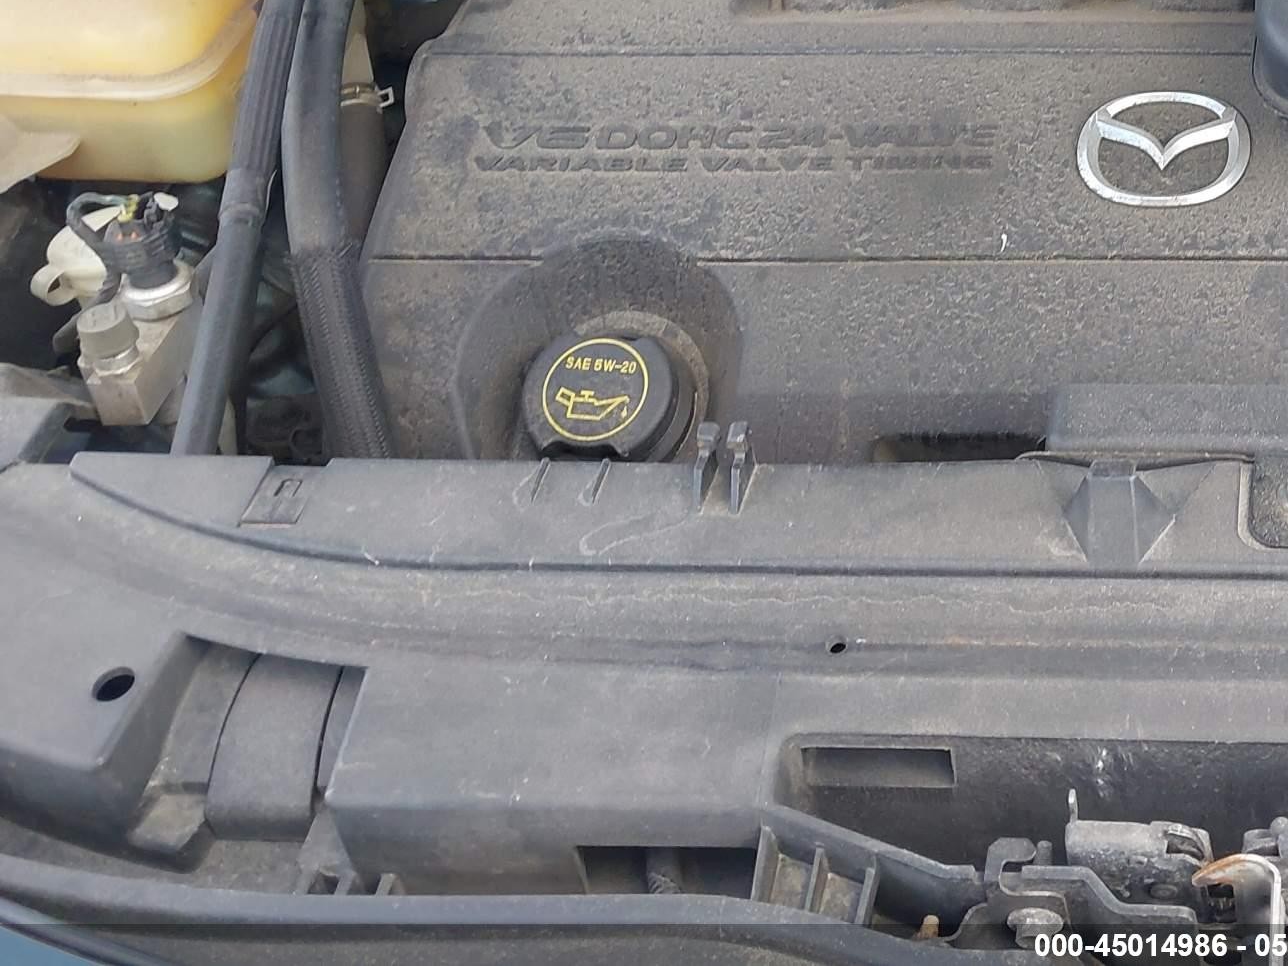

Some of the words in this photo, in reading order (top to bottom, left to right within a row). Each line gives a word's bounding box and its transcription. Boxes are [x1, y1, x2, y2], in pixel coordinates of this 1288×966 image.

[474, 155, 689, 172] VARIABLE
[701, 155, 834, 172] VALVE
[565, 356, 592, 371] SAE
